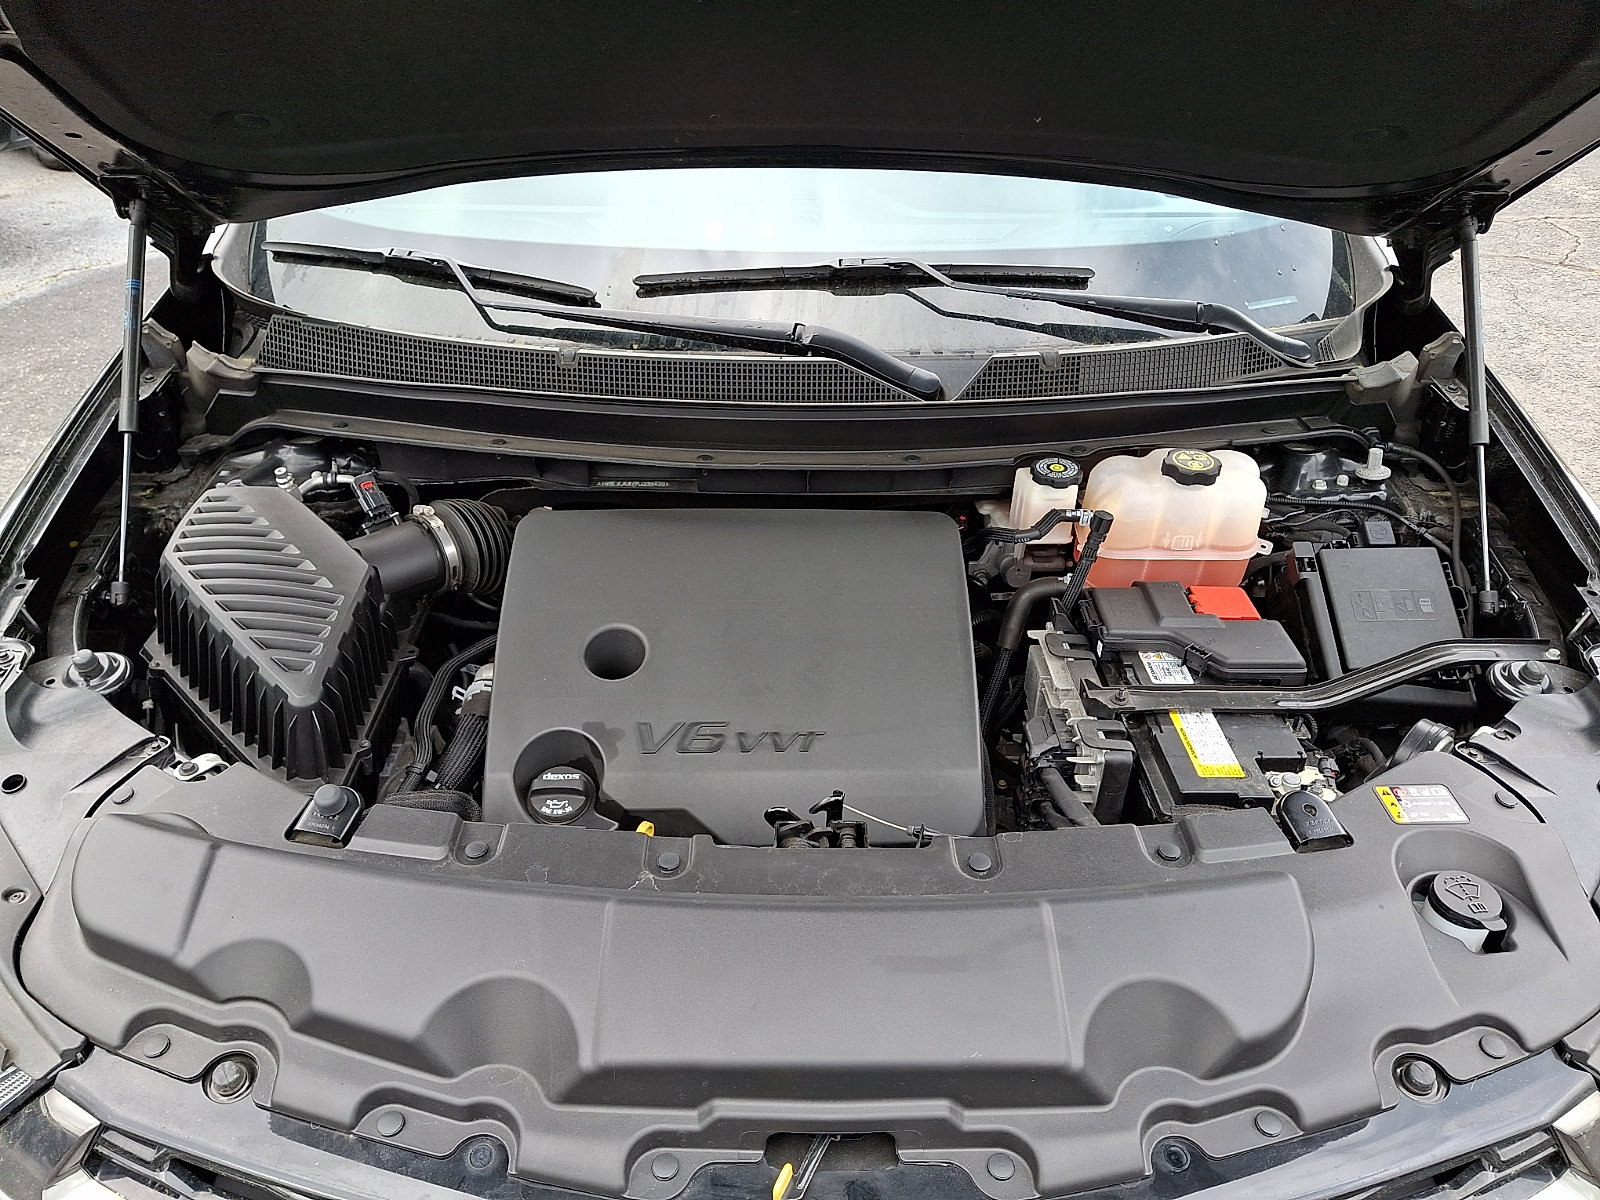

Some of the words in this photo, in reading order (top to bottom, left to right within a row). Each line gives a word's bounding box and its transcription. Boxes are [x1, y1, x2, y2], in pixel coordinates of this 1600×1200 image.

[636, 721, 729, 755] V6
[735, 730, 827, 753] VVT
[542, 772, 581, 780] dexos
